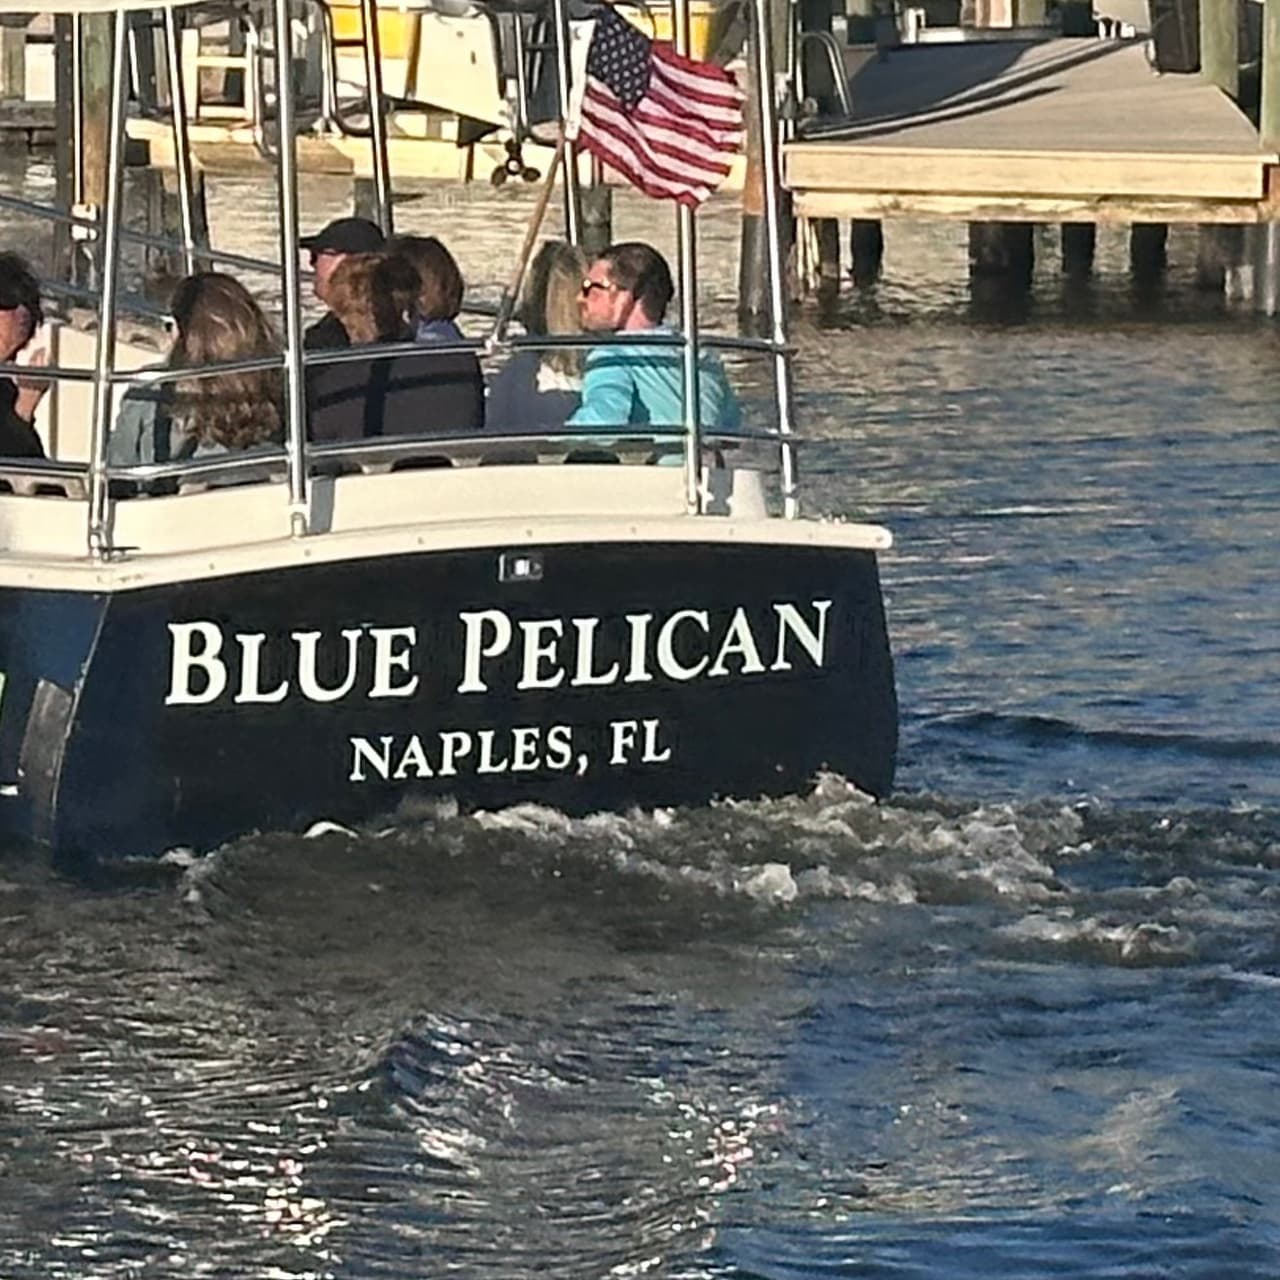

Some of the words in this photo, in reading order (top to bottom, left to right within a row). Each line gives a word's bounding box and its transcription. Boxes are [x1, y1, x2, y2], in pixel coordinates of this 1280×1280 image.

[164, 620, 421, 706] BLUE
[457, 599, 834, 695] PELICAN
[349, 724, 590, 783] NAPLES,
[609, 719, 672, 766] FL
